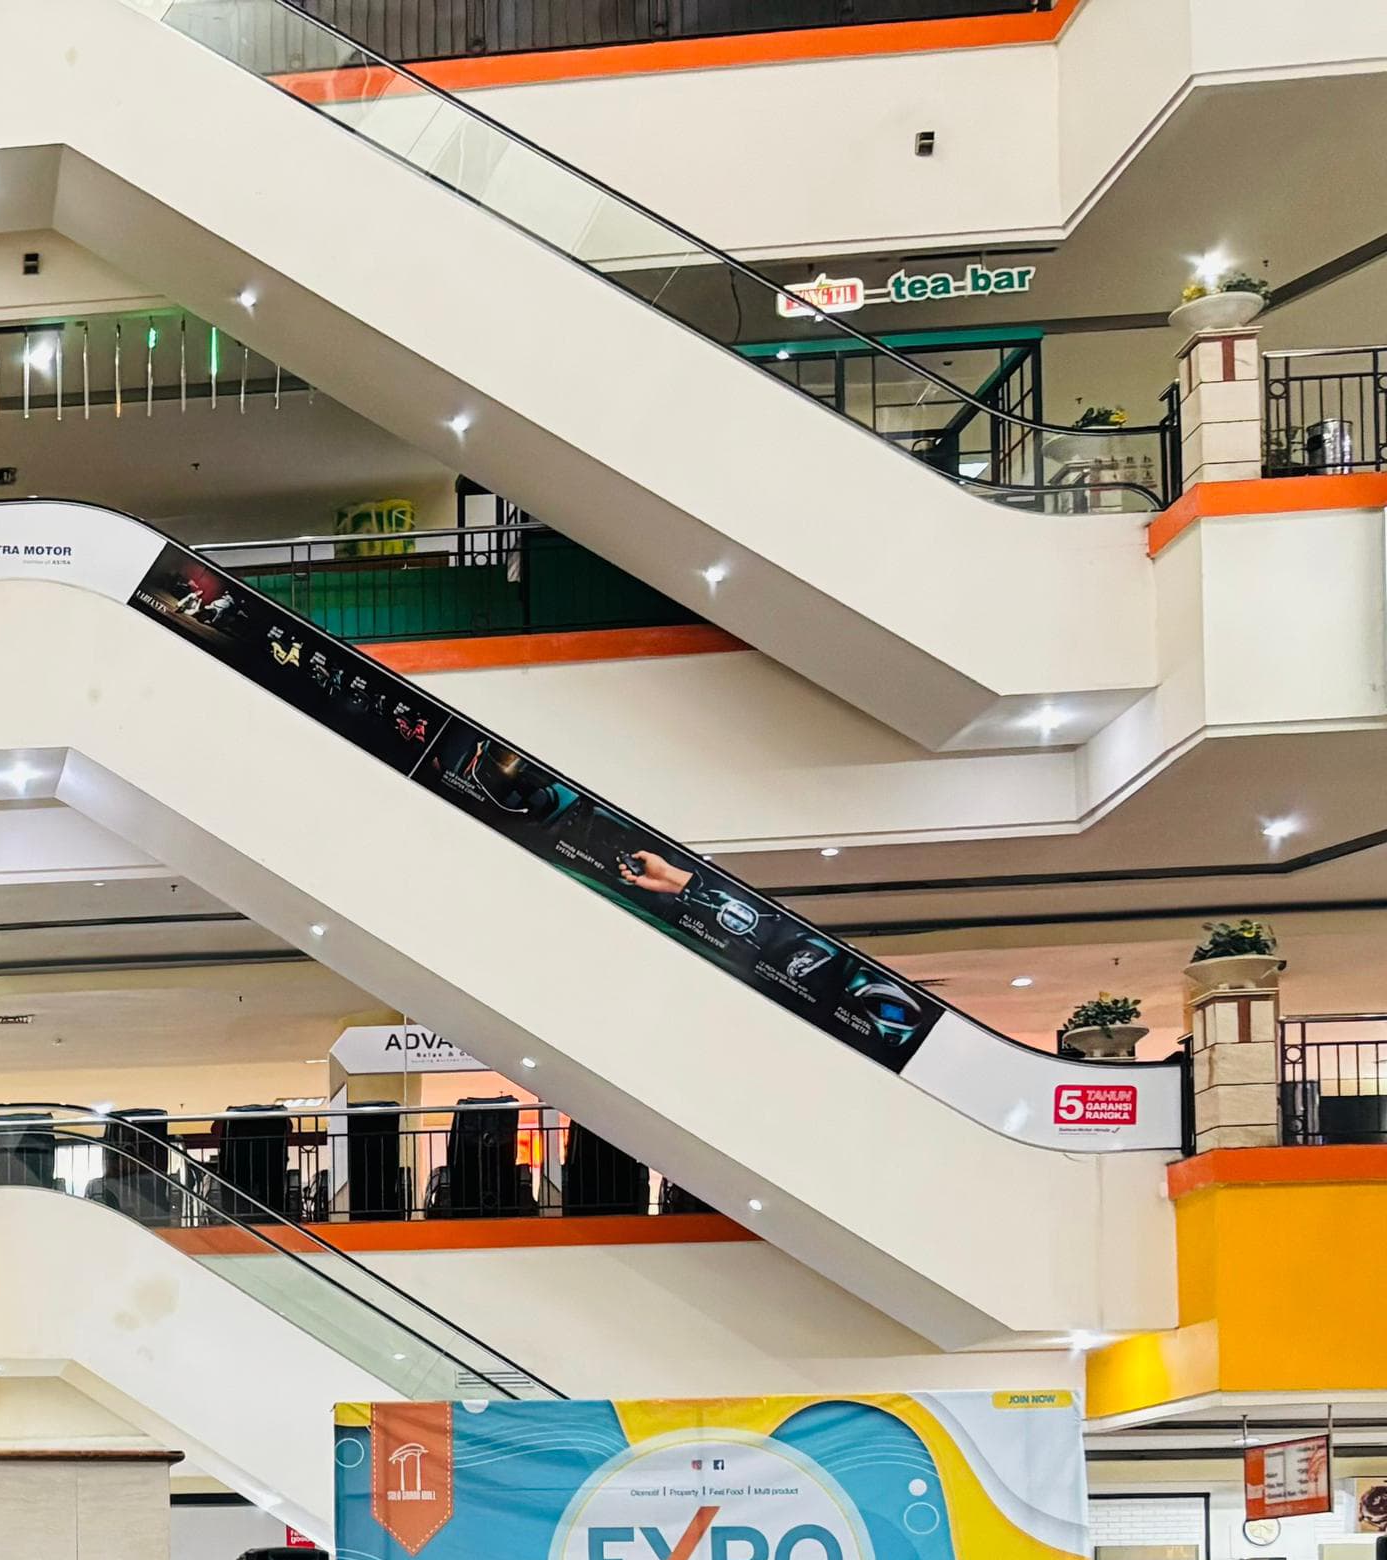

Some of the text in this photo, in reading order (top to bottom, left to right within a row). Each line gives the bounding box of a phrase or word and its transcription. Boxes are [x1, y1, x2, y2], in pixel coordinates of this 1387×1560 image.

[892, 267, 1031, 300] tea bar
[24, 546, 72, 556] MOTOR
[677, 917, 705, 937] LIGHTING
[849, 1013, 872, 1030] DIGITAL
[1058, 1089, 1132, 1120] 5 TAHUN
[1085, 1103, 1132, 1111] GARANSI
[1085, 1111, 1130, 1120] RANGKA
[1008, 1394, 1056, 1405] JOIN NOW
[670, 1488, 699, 1498] Property
[726, 1488, 744, 1496] Food
[771, 1487, 799, 1496] product
